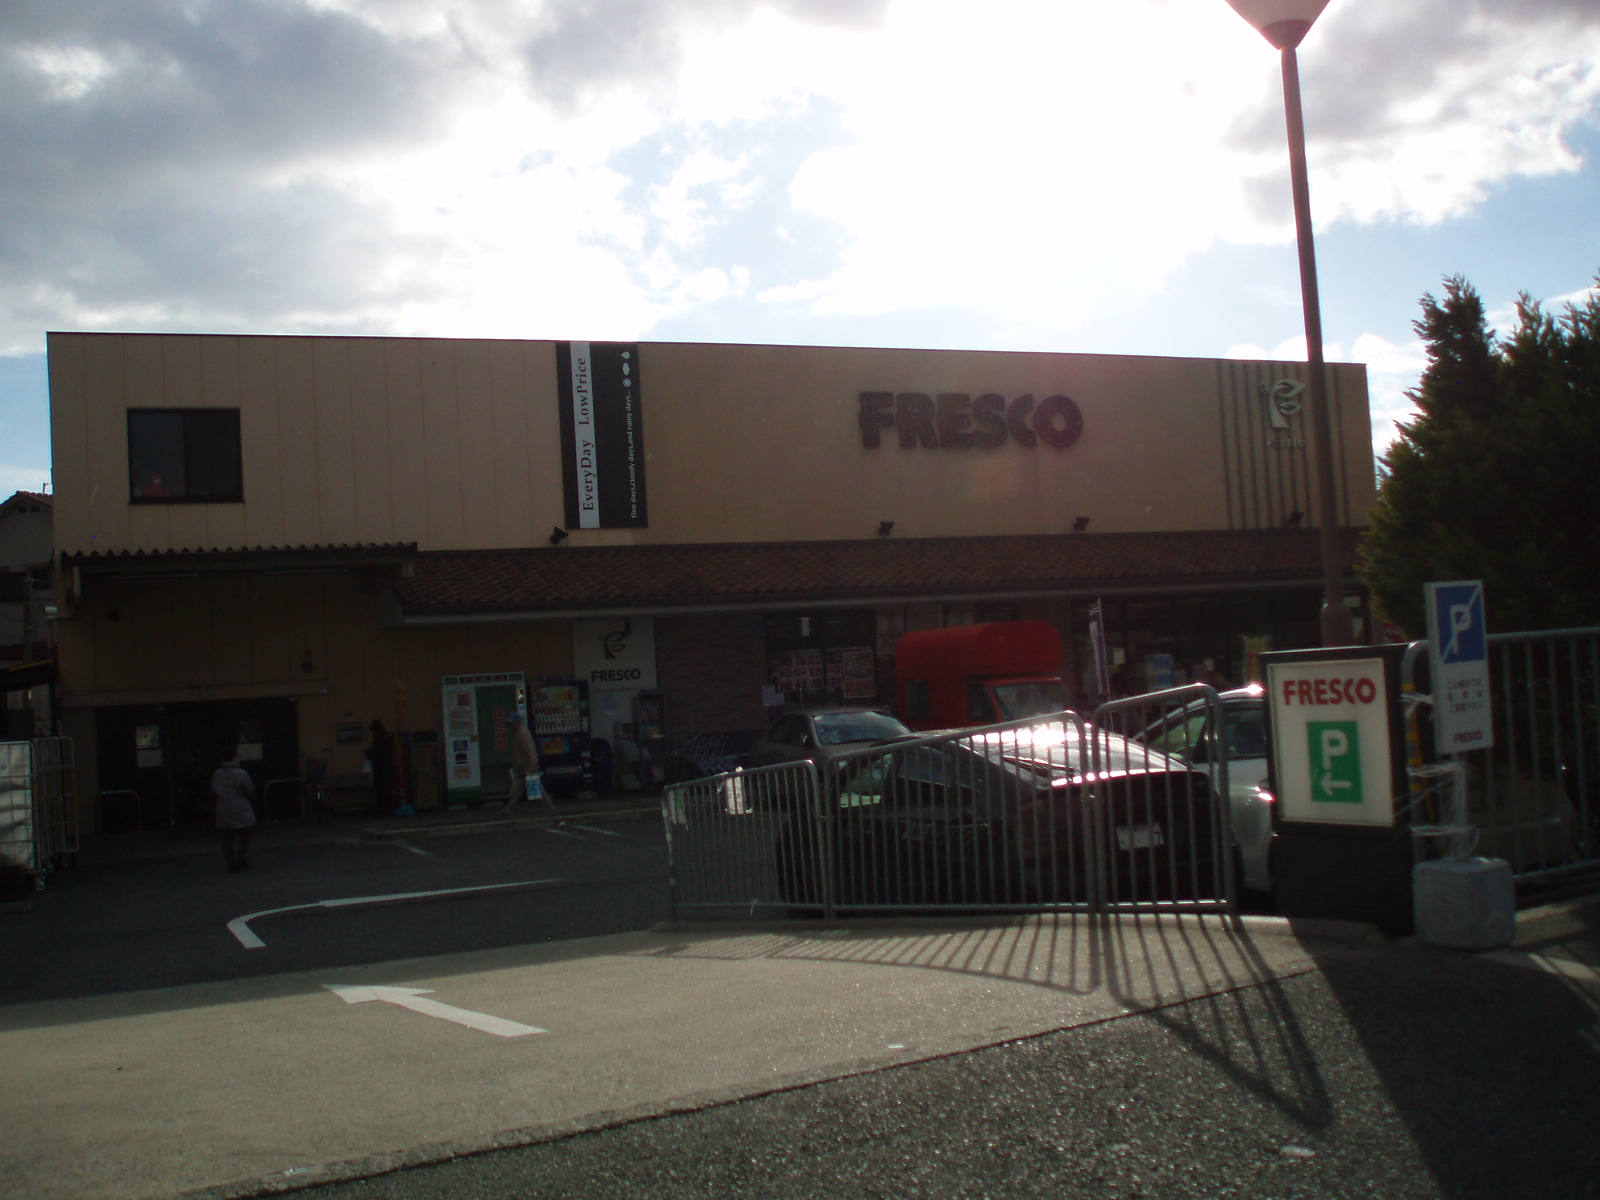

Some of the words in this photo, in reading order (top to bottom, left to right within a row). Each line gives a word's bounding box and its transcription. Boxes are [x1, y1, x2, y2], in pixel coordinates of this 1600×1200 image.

[577, 358, 590, 425] LowPrice
[858, 391, 1084, 449] FRESCO
[581, 440, 595, 511] EveryDay
[1449, 604, 1471, 654] P
[591, 668, 641, 682] FRESCO
[1283, 677, 1377, 706] FRESCO
[1320, 729, 1349, 771] P
[1453, 730, 1483, 744] FRESCO
